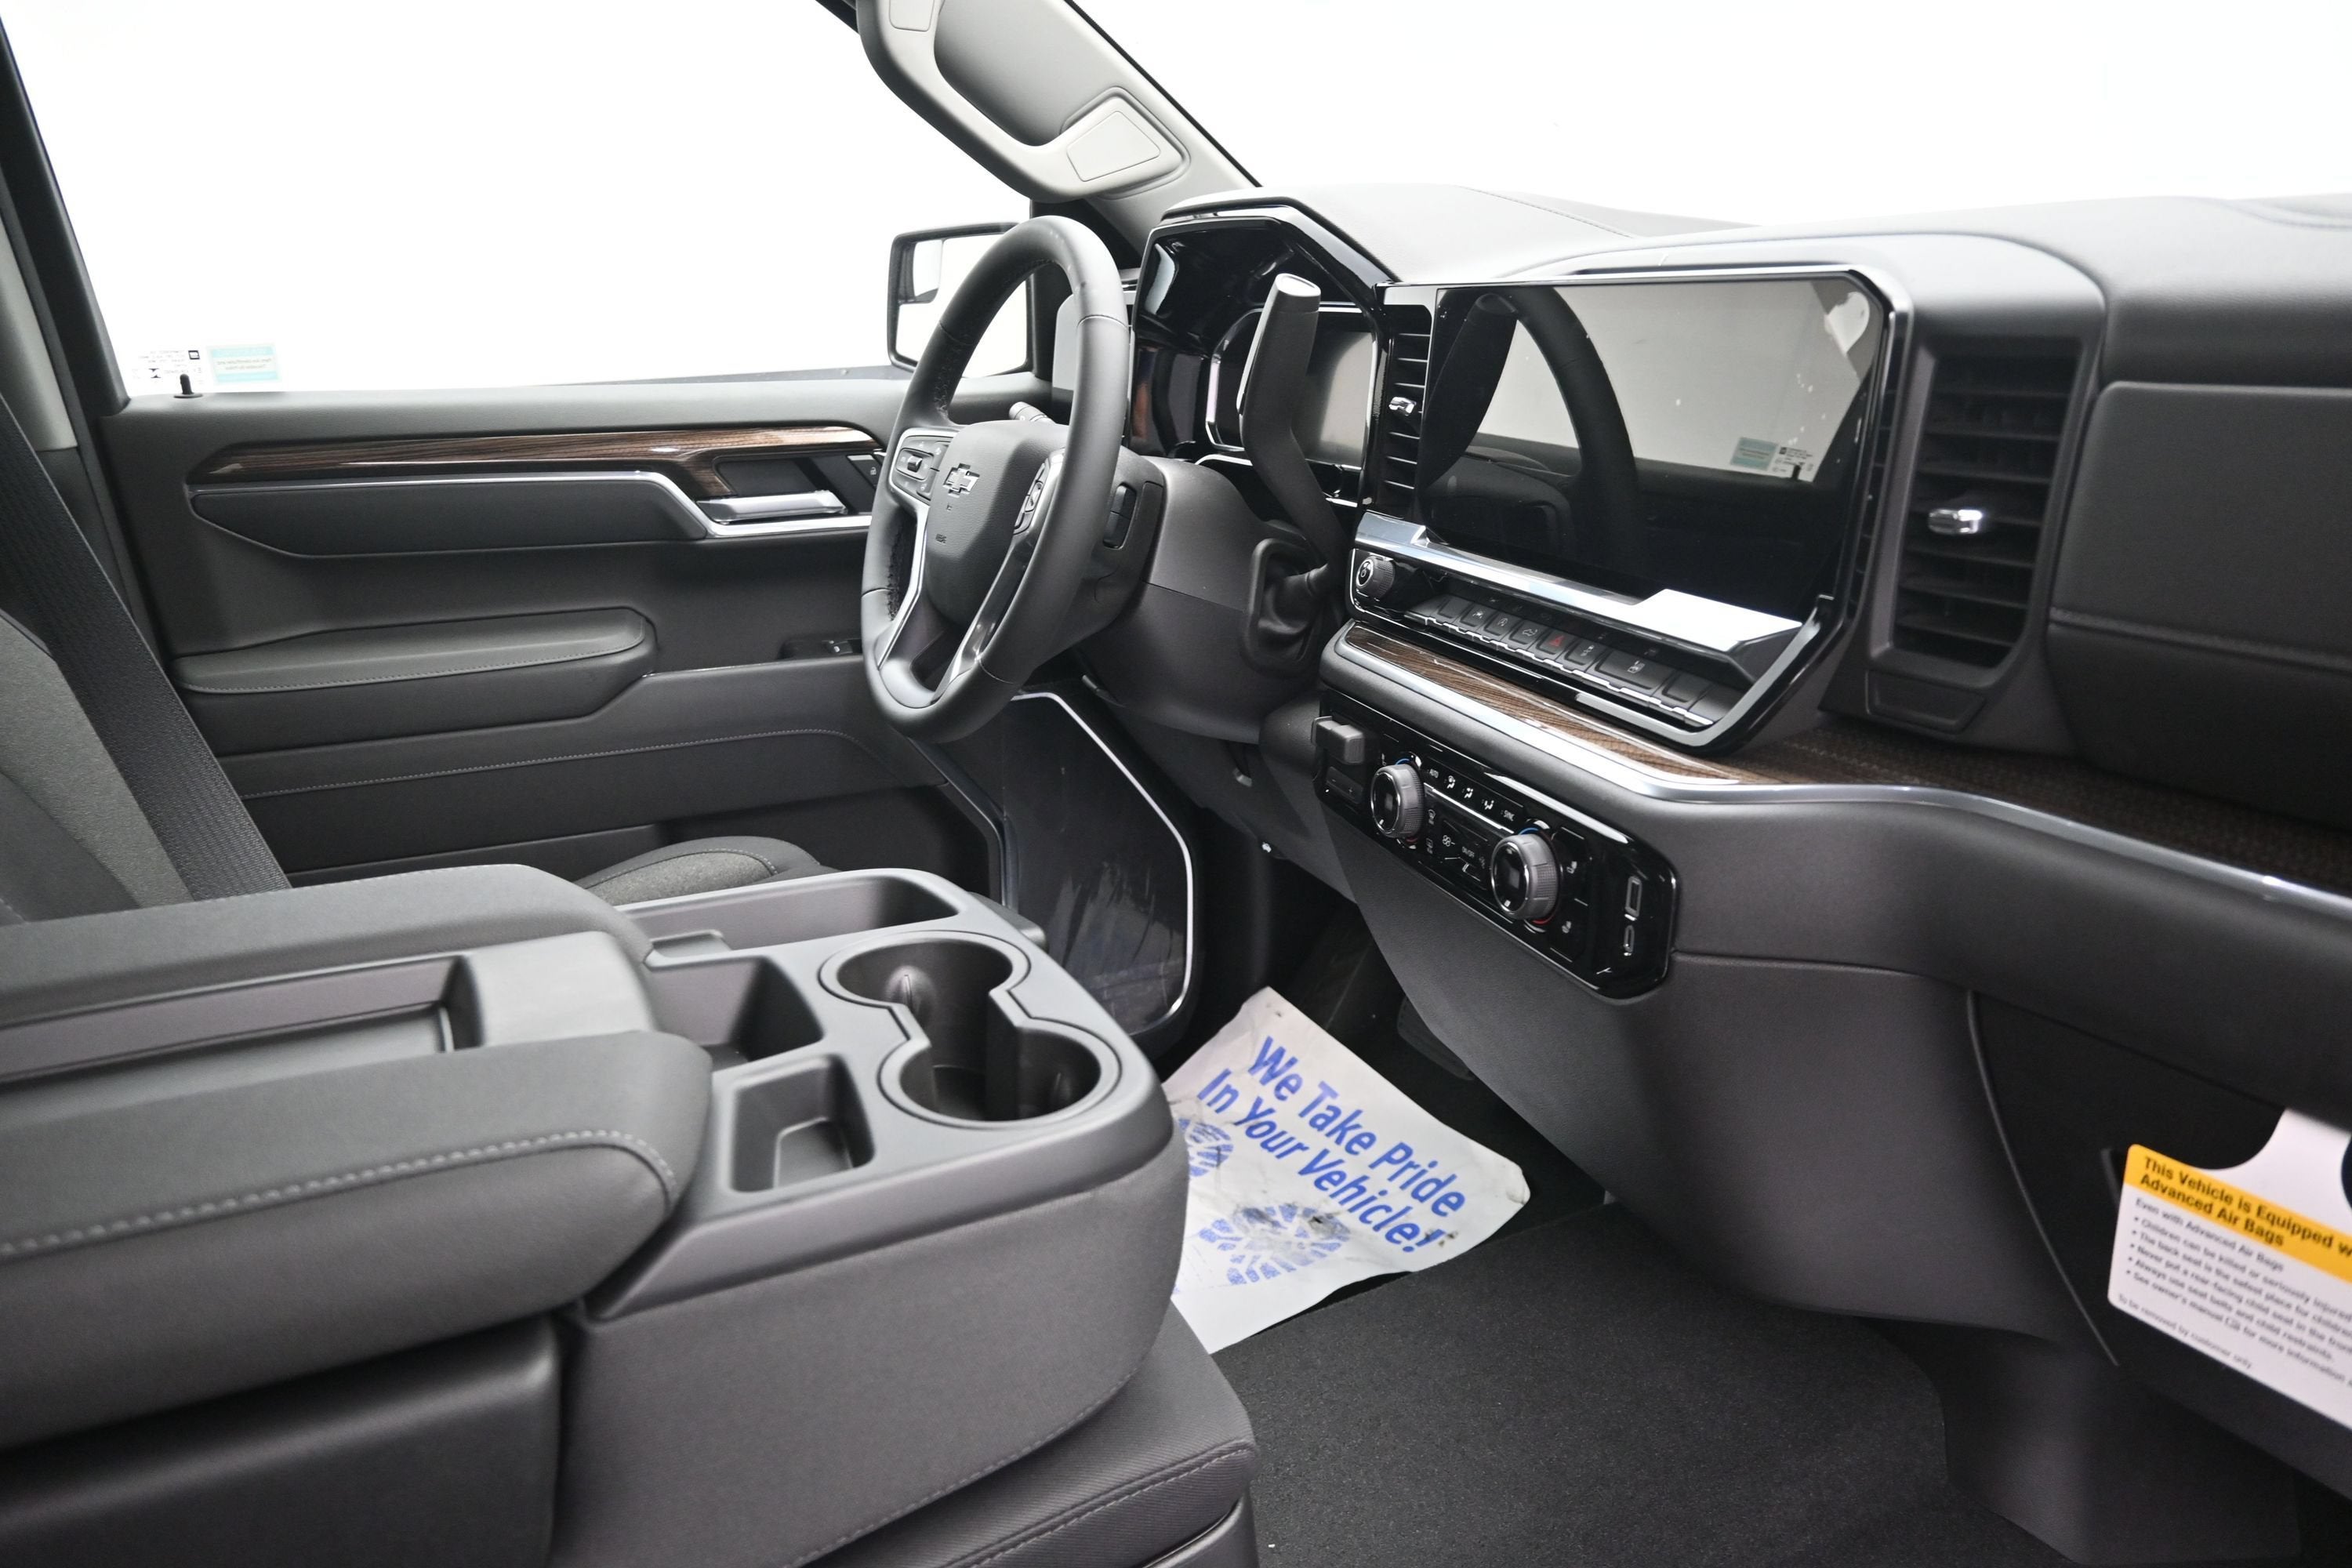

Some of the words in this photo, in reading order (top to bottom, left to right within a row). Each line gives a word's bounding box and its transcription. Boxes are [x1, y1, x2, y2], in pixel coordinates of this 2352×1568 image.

[1196, 1069, 1240, 1113] In
[1233, 1096, 1310, 1160] Your
[1298, 1148, 1446, 1253] Vehicle!
[1248, 1036, 1303, 1102] We
[1298, 1080, 1377, 1156] Take
[1368, 1142, 1466, 1217] Pride
[2136, 1197, 2159, 1214] Even
[2161, 1210, 2183, 1225] with
[2185, 1221, 2237, 1250] Advanced
[2238, 1244, 2253, 1257] Air
[2256, 1251, 2284, 1272] Bags
[2140, 1174, 2213, 1214] Advanced
[2217, 1207, 2240, 1225] Air
[2244, 1218, 2284, 1247] Bags
[2145, 1156, 2174, 1180] This
[2179, 1171, 2234, 1206] Vehicle
[2238, 1196, 2252, 1214] is
[2256, 1205, 2334, 1248] Equipped
[2132, 1272, 2151, 1286] See
[2189, 1300, 2224, 1323] manual
[2134, 1258, 2166, 1281] Always
[2168, 1276, 2186, 1288] use
[2187, 1285, 2209, 1300] seat
[2209, 1294, 2233, 1312] belts
[2235, 1308, 2255, 1323] and
[2256, 1318, 2281, 1336] child
[2136, 1245, 2164, 1263] Never
[2245, 1298, 2270, 1316] child
[2272, 1311, 2294, 1326] seat
[2296, 1320, 2307, 1331] in
[2308, 1327, 2326, 1341] the
[2140, 1218, 2181, 1241] Children
[2182, 1239, 2201, 1251] can
[2203, 1247, 2216, 1258] be
[2218, 1254, 2246, 1272] killed
[2248, 1269, 2259, 1279] or
[2262, 1276, 2310, 1305] seriously
[2140, 1232, 2156, 1246] The
[2158, 1240, 2180, 1256] back
[2181, 1254, 2202, 1267] seat
[2204, 1262, 2212, 1272] is
[2215, 1268, 2230, 1281] the
[2232, 1277, 2263, 1297] safest
[2263, 1292, 2292, 1310] place
[2294, 1304, 2309, 1318] for
